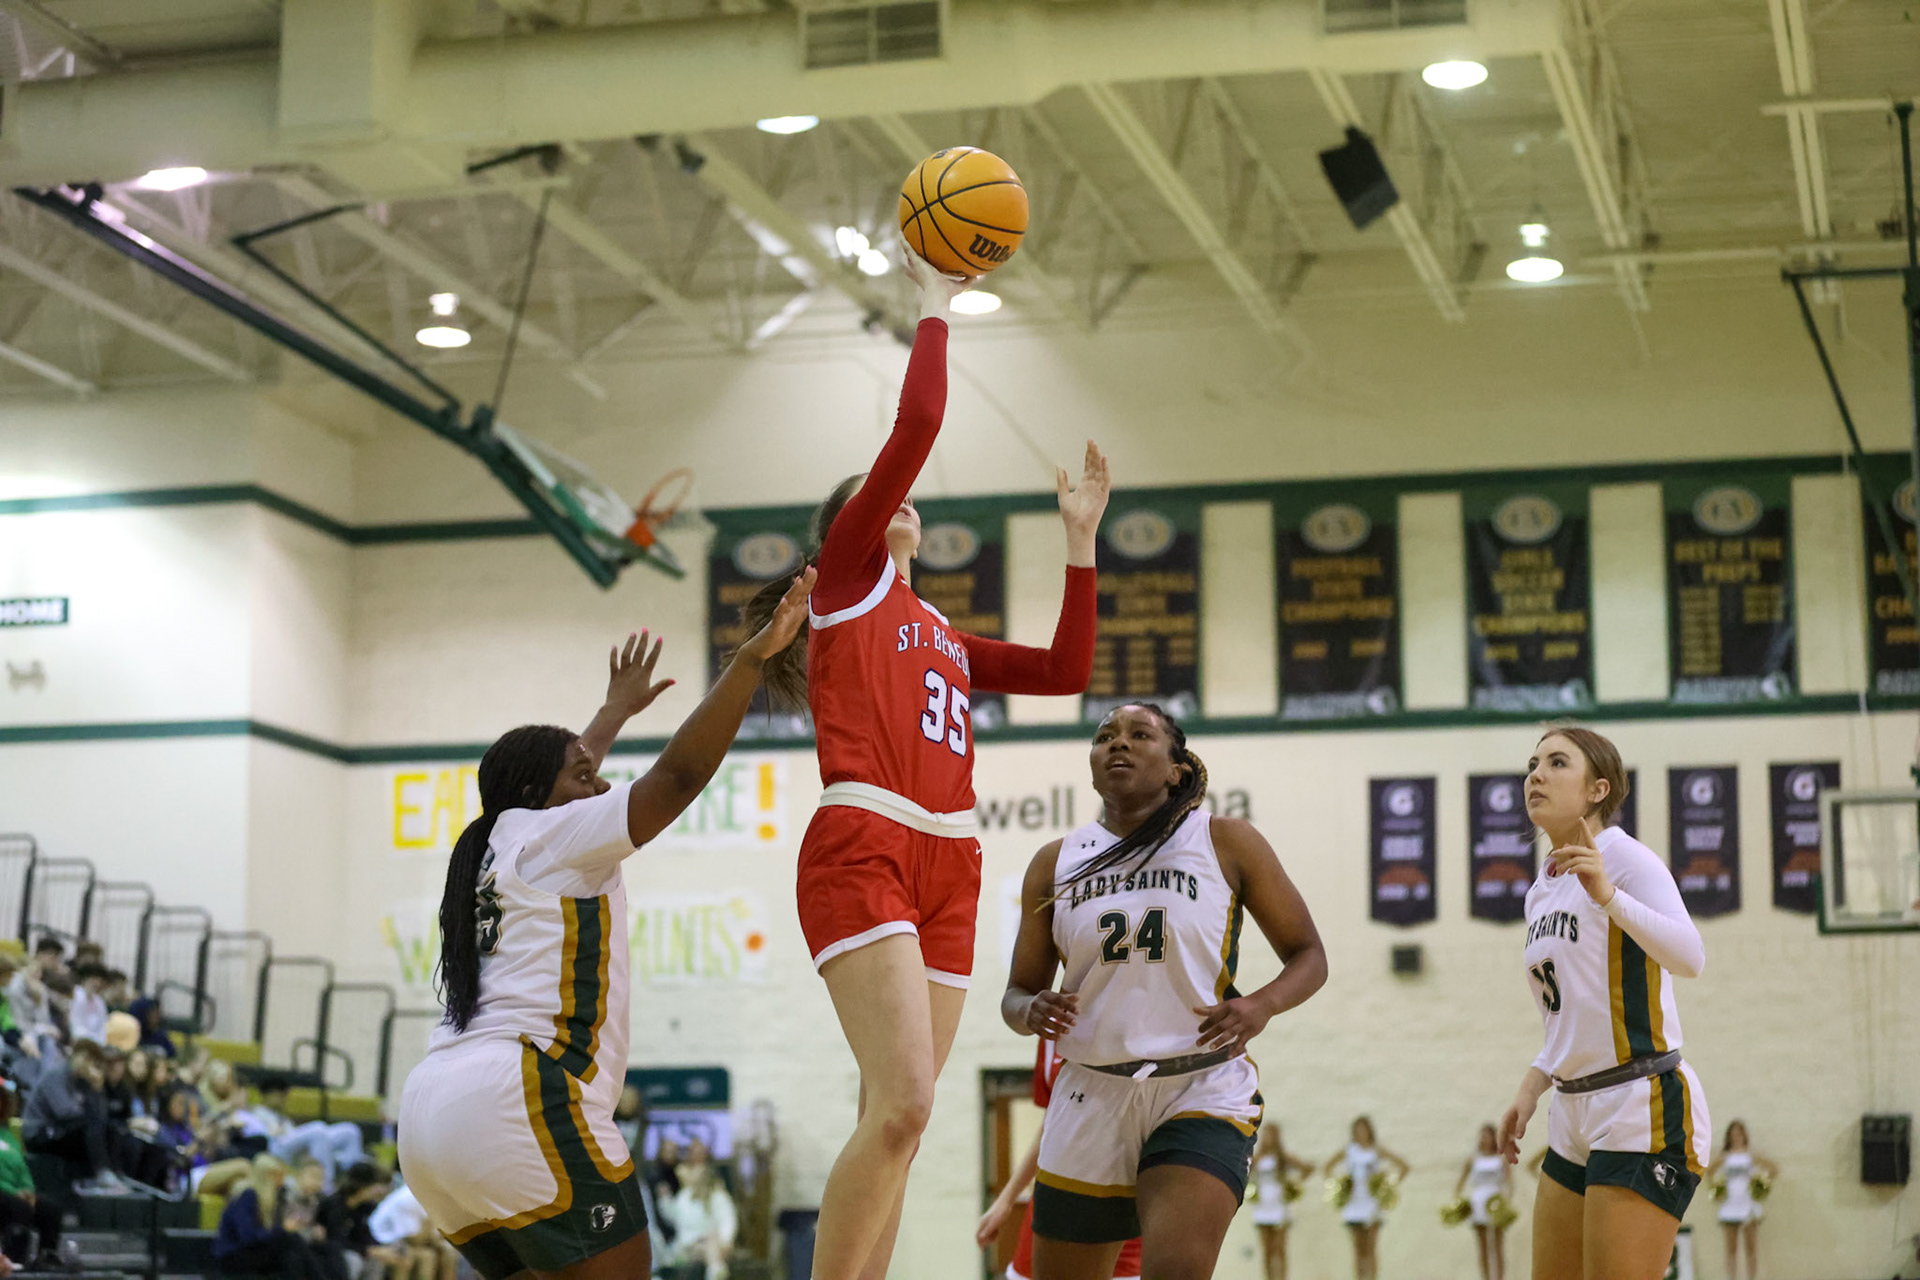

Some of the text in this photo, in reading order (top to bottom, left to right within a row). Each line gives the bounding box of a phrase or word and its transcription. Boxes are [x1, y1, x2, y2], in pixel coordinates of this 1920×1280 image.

[897, 622, 928, 652] ST.
[920, 668, 970, 758] 35
[1070, 869, 1198, 911] LADY SAINTS
[1097, 906, 1168, 966] 24
